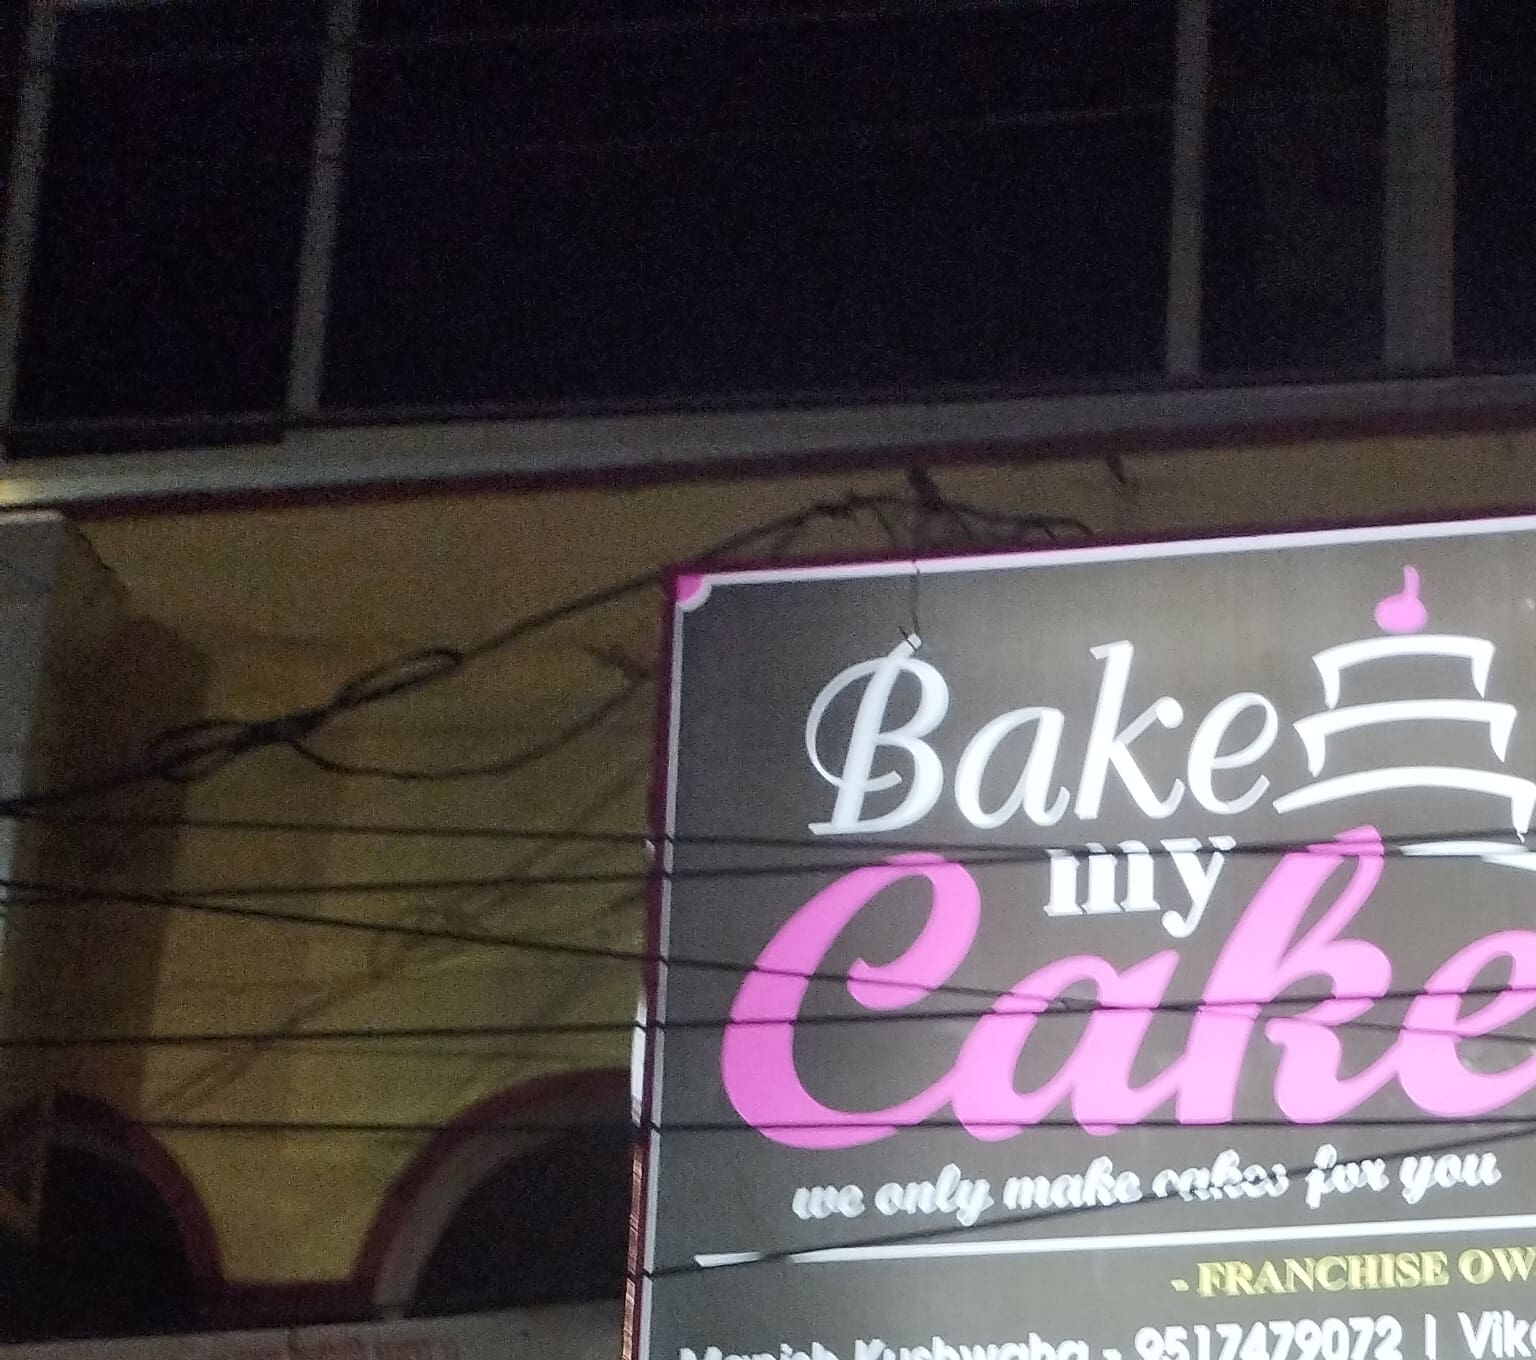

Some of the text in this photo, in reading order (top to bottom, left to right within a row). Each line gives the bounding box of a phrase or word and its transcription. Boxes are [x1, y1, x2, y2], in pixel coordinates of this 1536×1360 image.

[805, 632, 1280, 836] Bake
[1043, 835, 1237, 938] my
[791, 1143, 1502, 1227] we only make cakes for you
[1196, 1251, 1450, 1298] FRANCHISE
